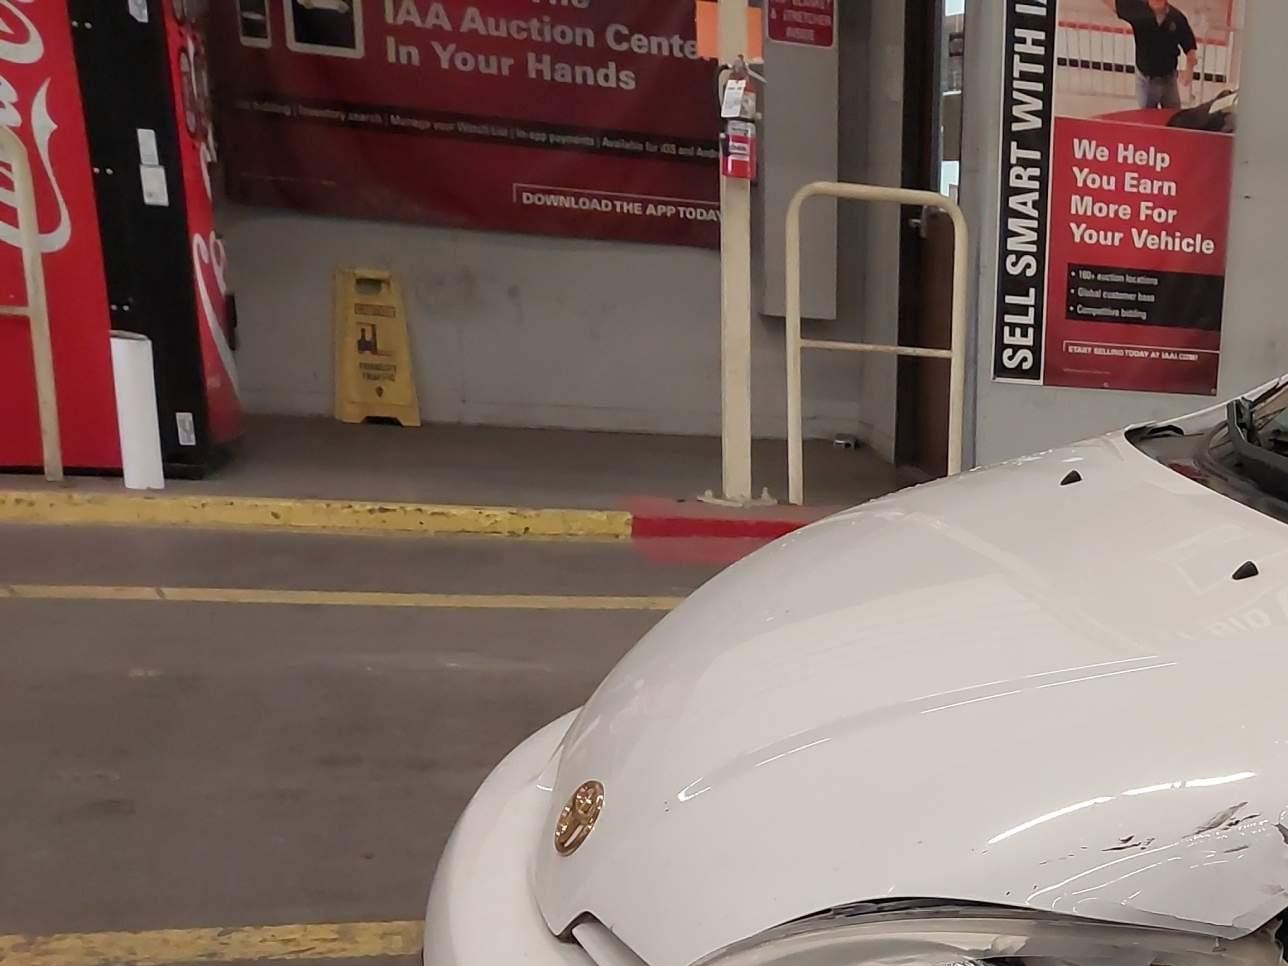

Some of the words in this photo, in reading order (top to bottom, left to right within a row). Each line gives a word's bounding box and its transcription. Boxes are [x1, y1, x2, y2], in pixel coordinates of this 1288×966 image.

[384, 0, 452, 31] IAA
[460, 7, 595, 48] Auction
[606, 23, 700, 60] Cente
[386, 36, 420, 66] In
[431, 41, 514, 76] Your
[527, 52, 636, 90] Hands
[1011, 28, 1046, 131] WITH
[1072, 138, 1109, 161] We
[1117, 144, 1170, 171] Help
[1072, 167, 1116, 191] You
[1124, 172, 1177, 196] Earn
[522, 191, 612, 212] DOWNLOAD
[613, 202, 644, 215] THE
[645, 203, 677, 218] APP
[1005, 141, 1041, 277] SMART
[1070, 195, 1132, 220] More
[1139, 202, 1178, 223] For
[1069, 223, 1124, 246] Your
[1131, 228, 1215, 254] Vehicle
[1002, 287, 1035, 370] SELL
